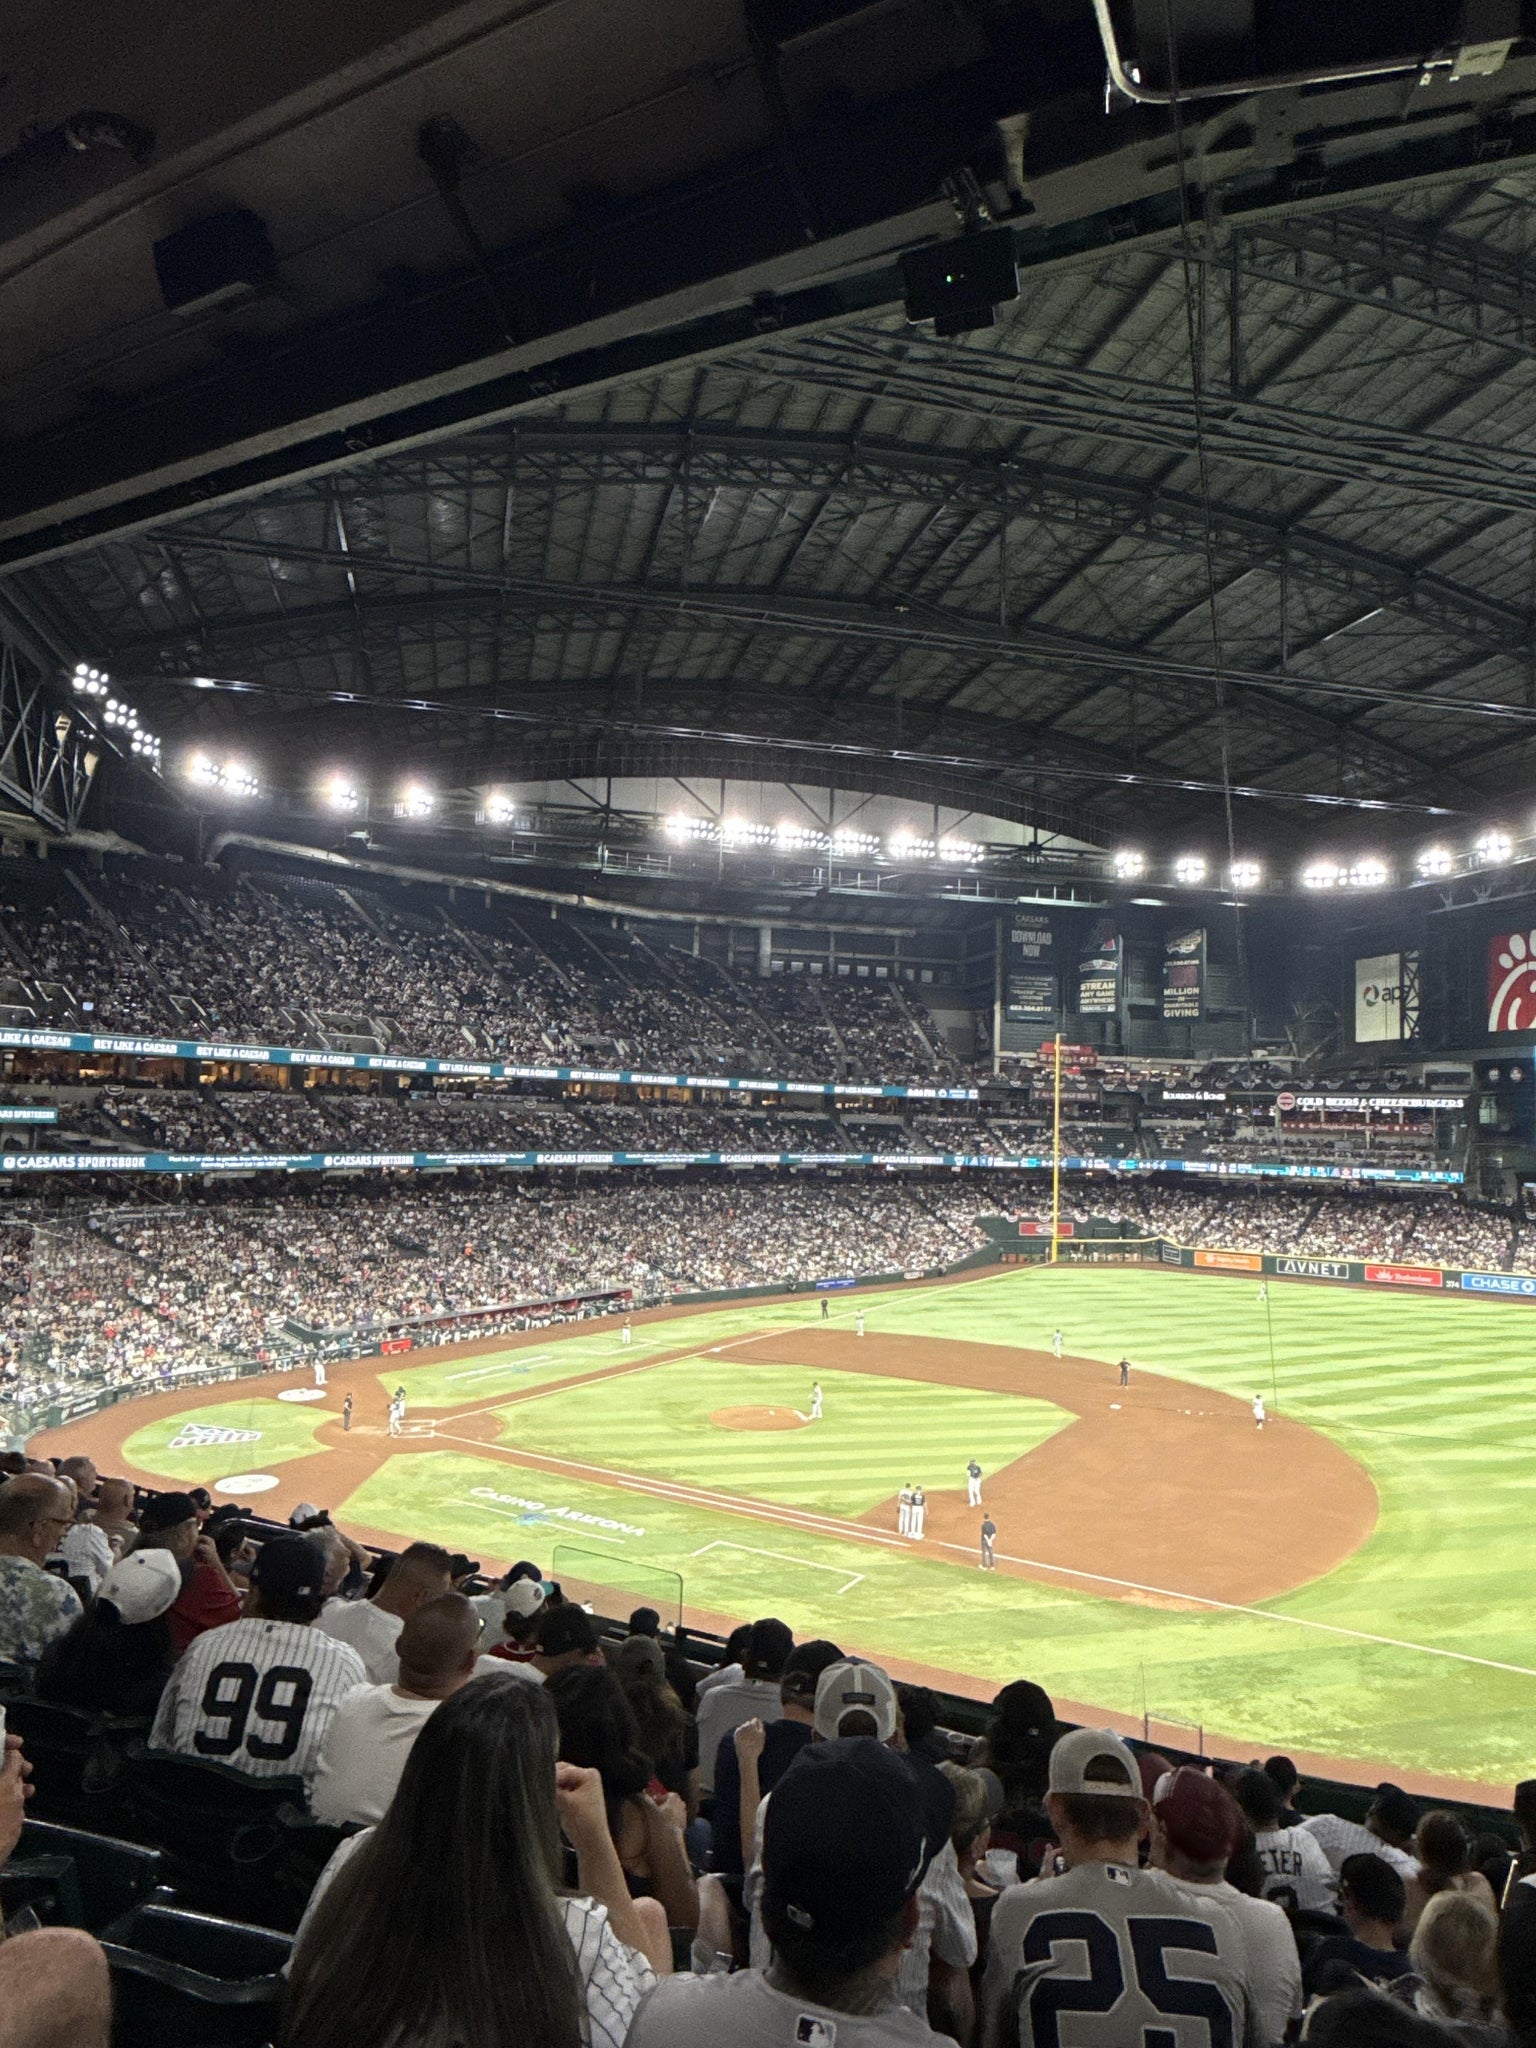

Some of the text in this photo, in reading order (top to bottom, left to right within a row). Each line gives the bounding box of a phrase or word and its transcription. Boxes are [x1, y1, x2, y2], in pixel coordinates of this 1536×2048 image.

[1011, 930, 1053, 945] DOWNLOAD
[1023, 944, 1041, 957] NOW
[1080, 982, 1116, 990] STREAM
[1163, 987, 1199, 996] MILLION
[1163, 1008, 1199, 1018] GIVING
[22, 1034, 30, 1044] A
[31, 1035, 72, 1047] CAESAR
[1195, 1091, 1203, 1100] &
[1296, 1097, 1324, 1106] COLD
[1325, 1097, 1360, 1106] BEERS
[1368, 1098, 1465, 1108] CHEESEBURGERS
[16, 1156, 146, 1169] CAESARS SPORTSBOOK
[333, 1155, 372, 1166] CAESARS
[1284, 1259, 1341, 1276] AVNET
[1471, 1277, 1520, 1291] CHASE
[194, 1661, 314, 1761] 99
[1258, 1848, 1303, 1877] ETER
[1022, 1908, 1234, 2048] 25
